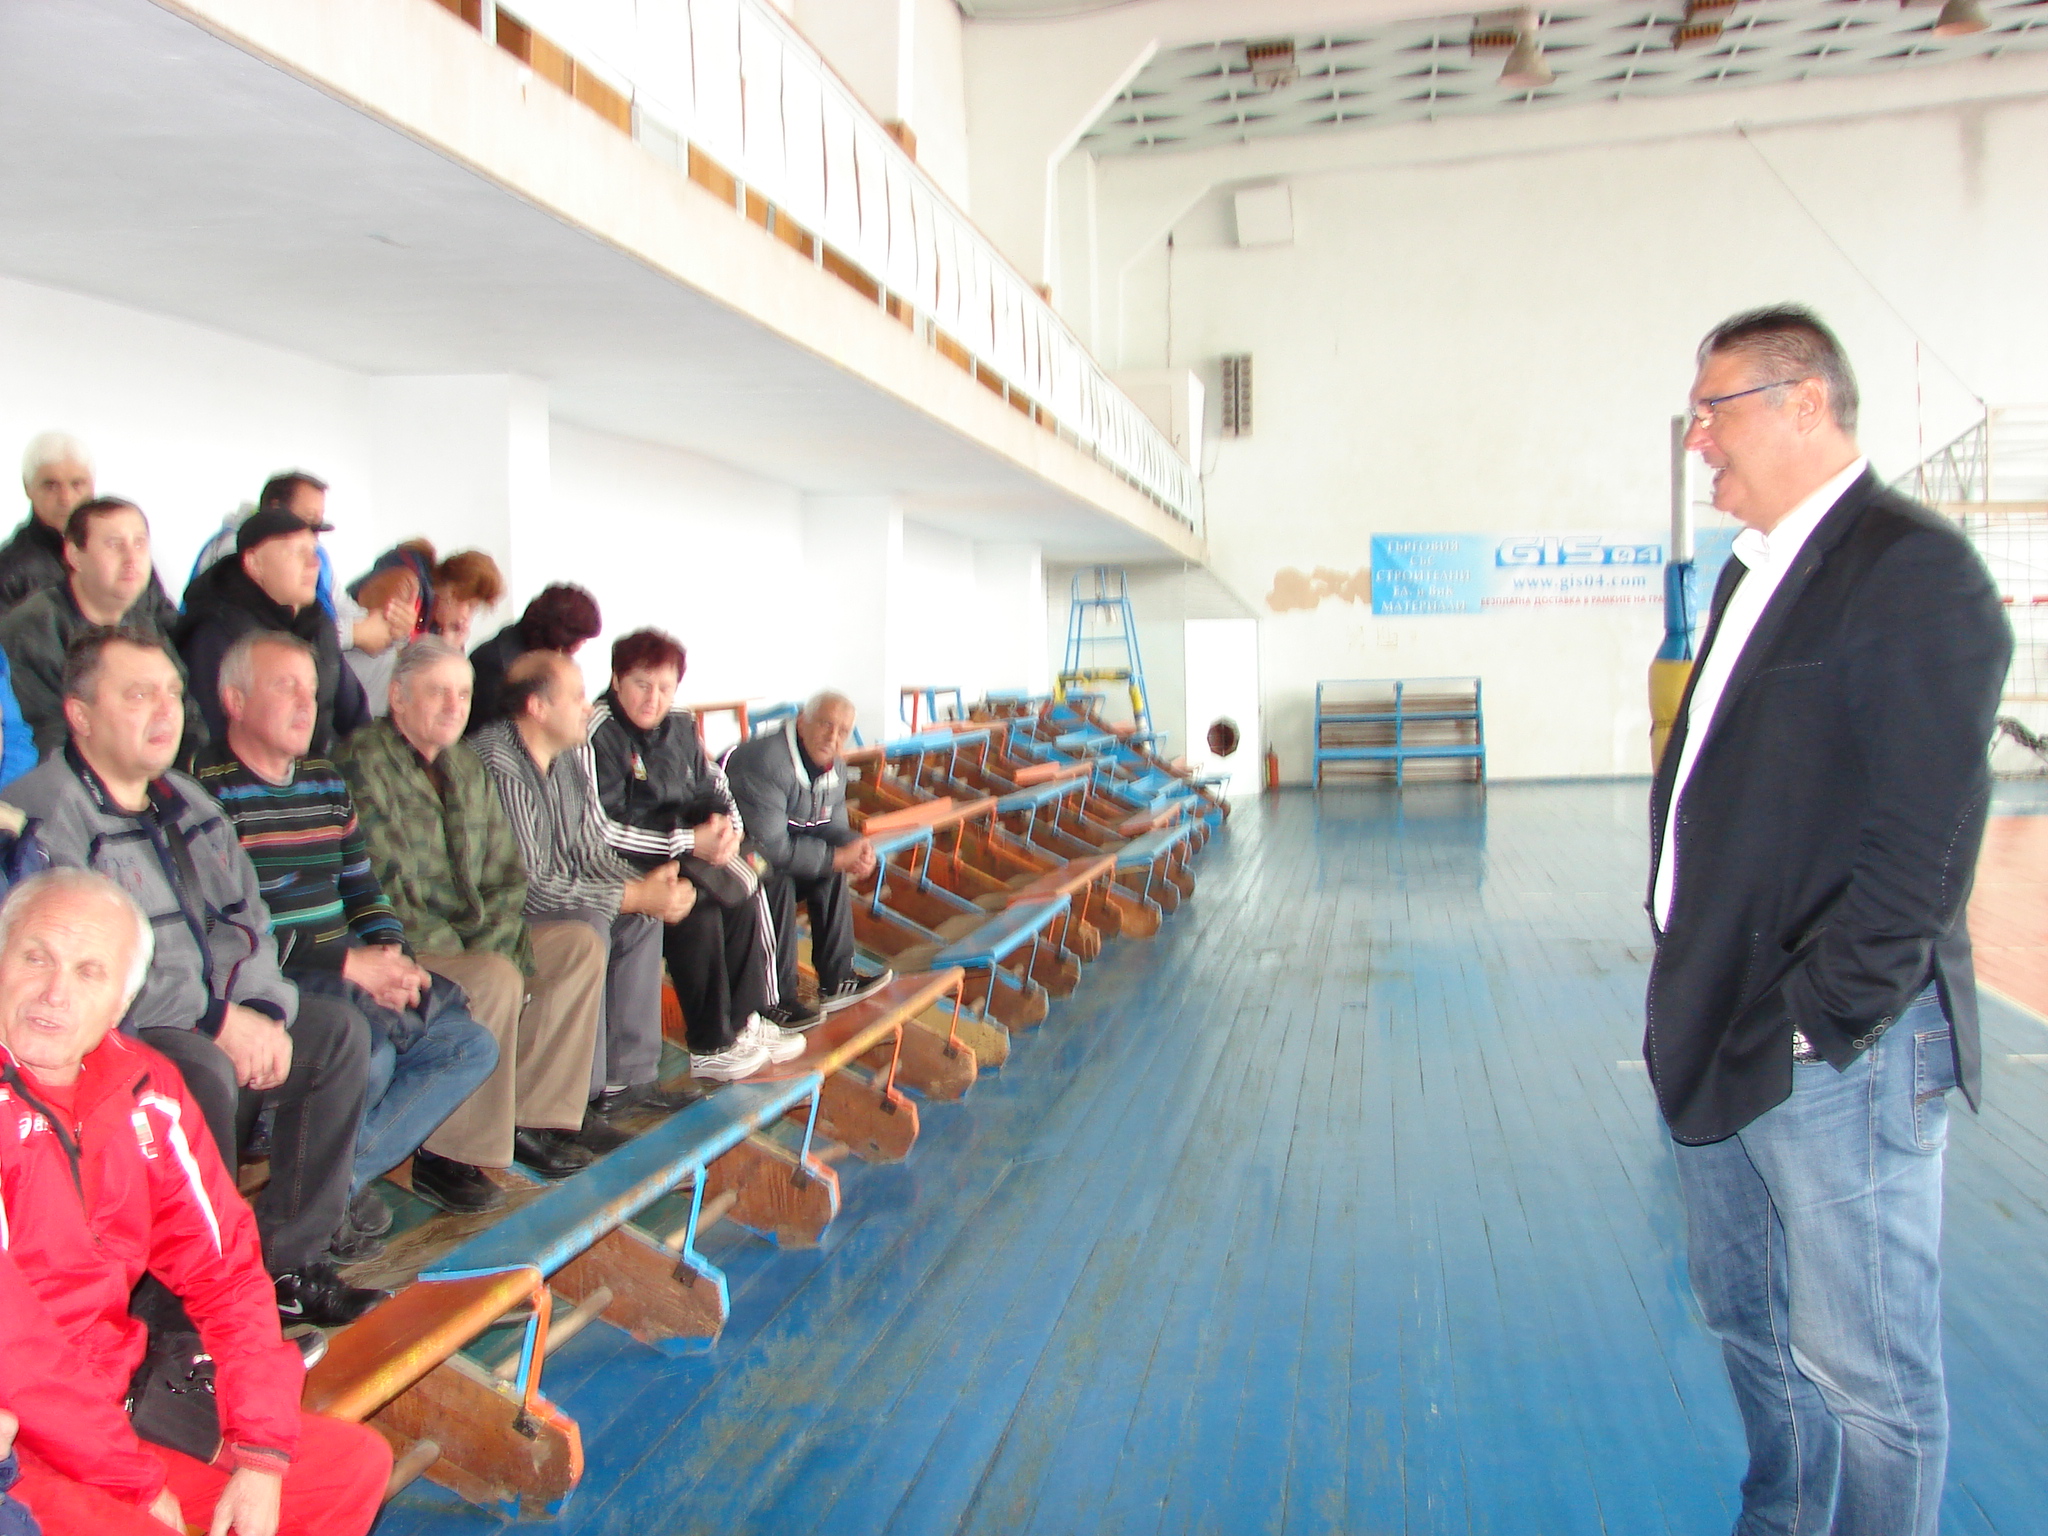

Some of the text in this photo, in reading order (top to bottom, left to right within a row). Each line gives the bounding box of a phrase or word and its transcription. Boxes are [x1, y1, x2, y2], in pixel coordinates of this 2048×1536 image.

[1387, 540, 1459, 551] ТЪРГОВИЯ
[1376, 570, 1470, 581] СТРОИТЕЛНИ
[1513, 573, 1647, 591] www.gis04.com
[1381, 600, 1466, 612] МАТЕРИАЛИ
[1481, 597, 1531, 605] БЕЗПЛАТНА
[1534, 596, 1582, 606] ДОСТАВКА
[1591, 595, 1631, 603] РАМКИТЕ
[1634, 594, 1646, 603] НА
[1649, 594, 1664, 603] ГРА
